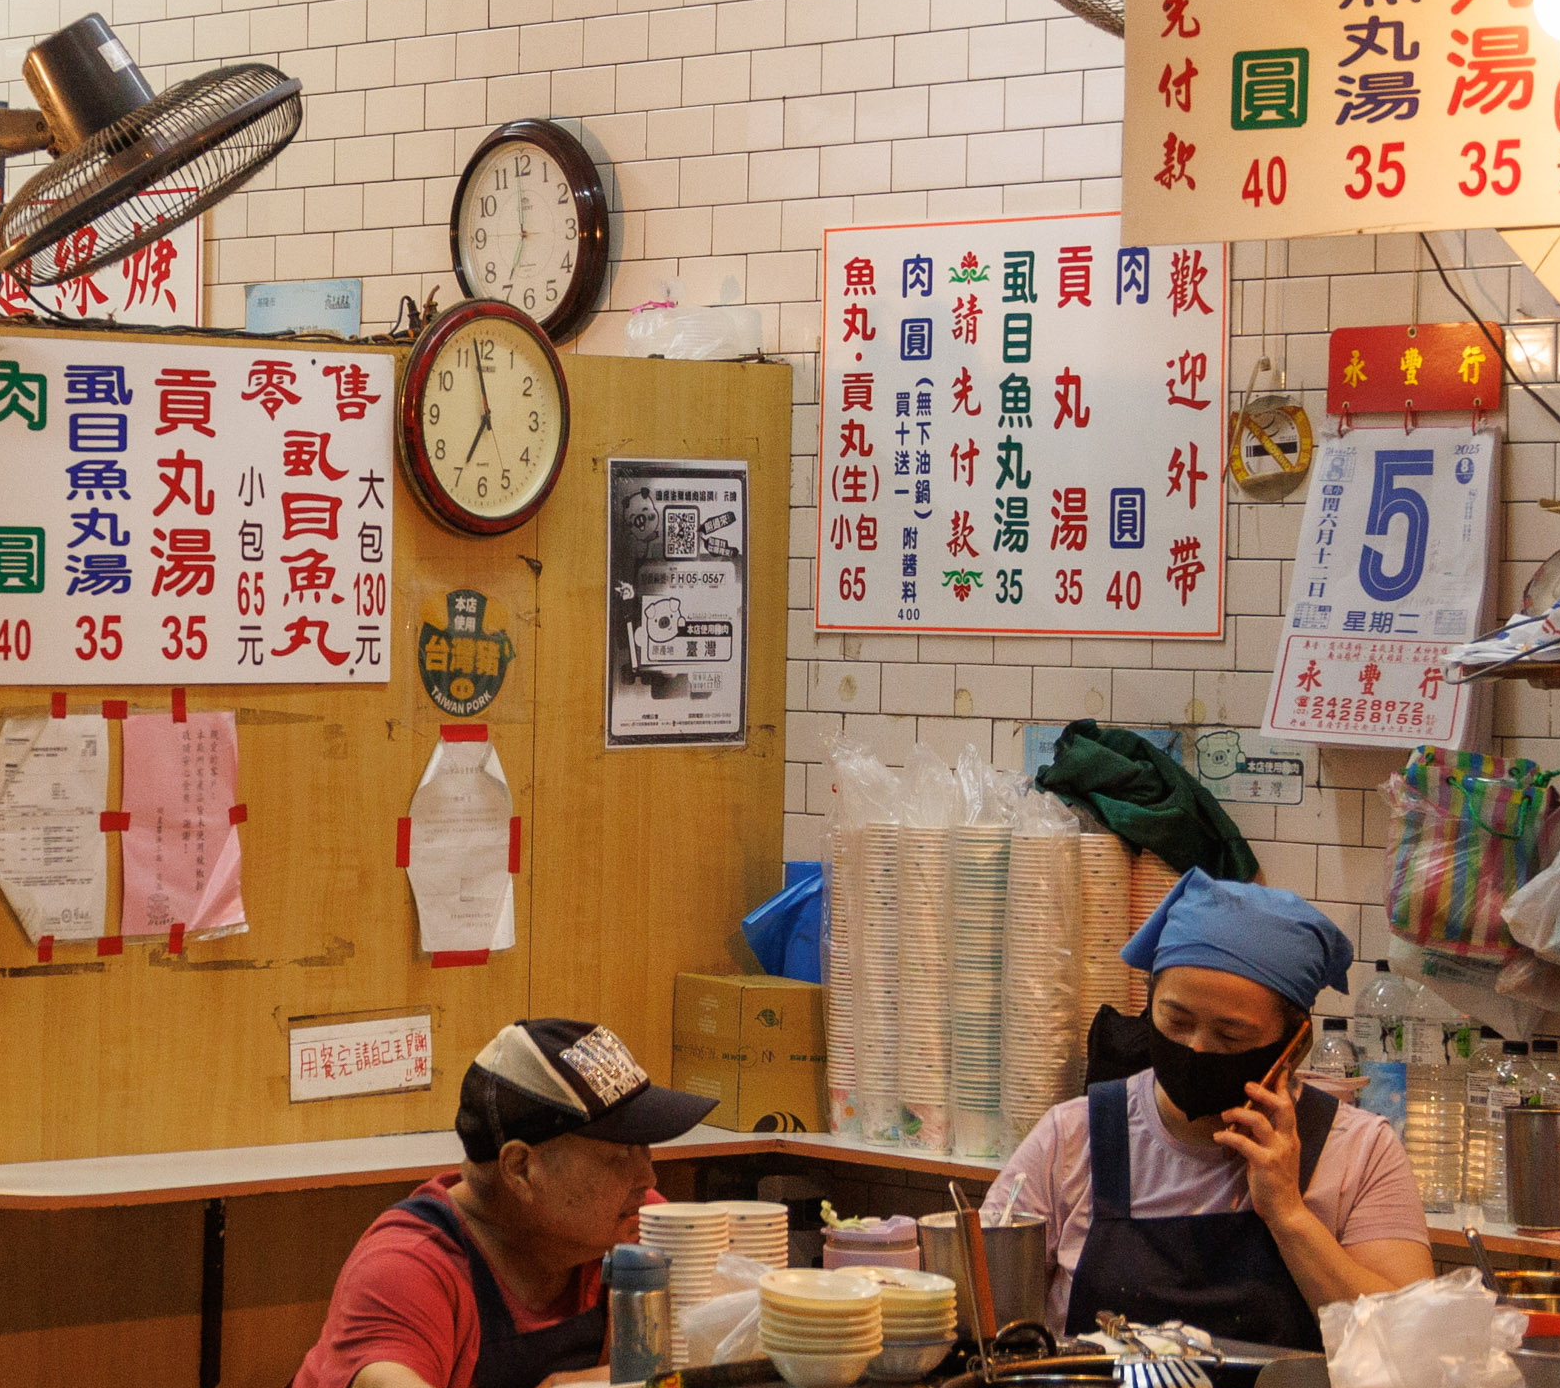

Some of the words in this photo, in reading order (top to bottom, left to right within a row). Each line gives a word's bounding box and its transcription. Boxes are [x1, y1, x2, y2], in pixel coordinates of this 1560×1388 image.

[513, 153, 533, 178] 12
[541, 161, 550, 184] 1
[1345, 141, 1406, 200] 35
[1459, 139, 1522, 197] 35
[494, 168, 509, 191] 11
[1242, 155, 1287, 208] 40
[479, 194, 498, 218] 10
[556, 183, 570, 205] 2
[474, 228, 487, 250] 9
[564, 218, 577, 242] 3
[484, 261, 497, 283] 8
[559, 251, 574, 274] 4
[522, 287, 536, 310] 6
[545, 279, 559, 302] 5
[900, 254, 934, 362] 肉圓
[455, 347, 470, 368] 11
[479, 339, 494, 361] 12
[508, 349, 515, 370] 1
[1342, 345, 1487, 389] 永豐行
[240, 359, 382, 422] 零售
[438, 369, 454, 392] 10
[522, 376, 533, 397] 2
[993, 250, 1038, 553] 虱目魚丸湯
[1050, 245, 1092, 551] 貢丸湯
[428, 403, 440, 425] 9
[527, 411, 539, 433] 3
[946, 294, 983, 559] 請先付款
[1165, 248, 1214, 607] 歡迎外帶
[434, 439, 446, 460] 8
[894, 391, 911, 497] 買十送一
[519, 446, 531, 467] 4
[64, 363, 133, 597] 虱目魚丸湯
[151, 367, 218, 598] 貢丸湯
[454, 467, 464, 488] 7
[477, 476, 488, 498] 6
[500, 469, 511, 491] 5
[1358, 449, 1434, 602] 5
[271, 429, 351, 667] 虱目魚丸
[838, 566, 867, 603] 65
[995, 569, 1024, 606] 35
[1055, 569, 1083, 606] 35
[1106, 571, 1142, 611] 40
[455, 596, 477, 613] 本店
[897, 608, 920, 622] 400
[454, 615, 476, 632] 使用
[1342, 610, 1420, 634] 星期二
[75, 615, 124, 662] 35
[160, 615, 209, 662] 35
[1296, 659, 1444, 701] 永豐行
[430, 685, 464, 713] TAIWAN
[466, 690, 493, 713] PORK
[1312, 695, 1425, 713] 24228872
[1311, 708, 1423, 726] 24258155
